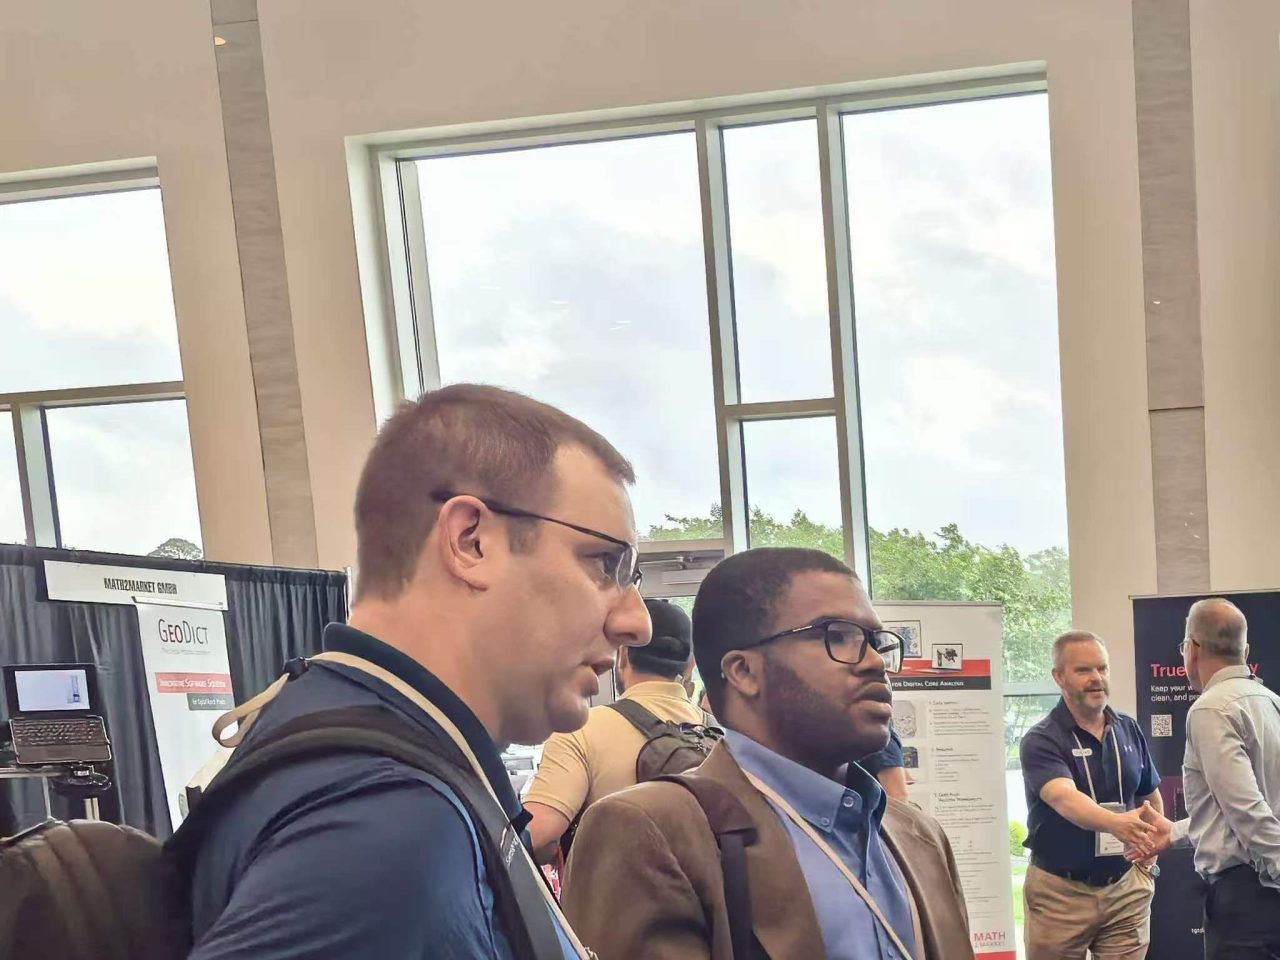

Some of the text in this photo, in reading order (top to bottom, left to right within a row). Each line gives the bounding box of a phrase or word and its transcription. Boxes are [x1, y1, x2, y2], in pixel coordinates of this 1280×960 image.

[104, 578, 177, 595] MATH2MARKET GMBH
[1150, 685, 1168, 693] Keep
[1170, 685, 1185, 693] your
[1150, 694, 1172, 702] clean,
[1174, 693, 1187, 701] and
[974, 931, 1006, 941] MATH
